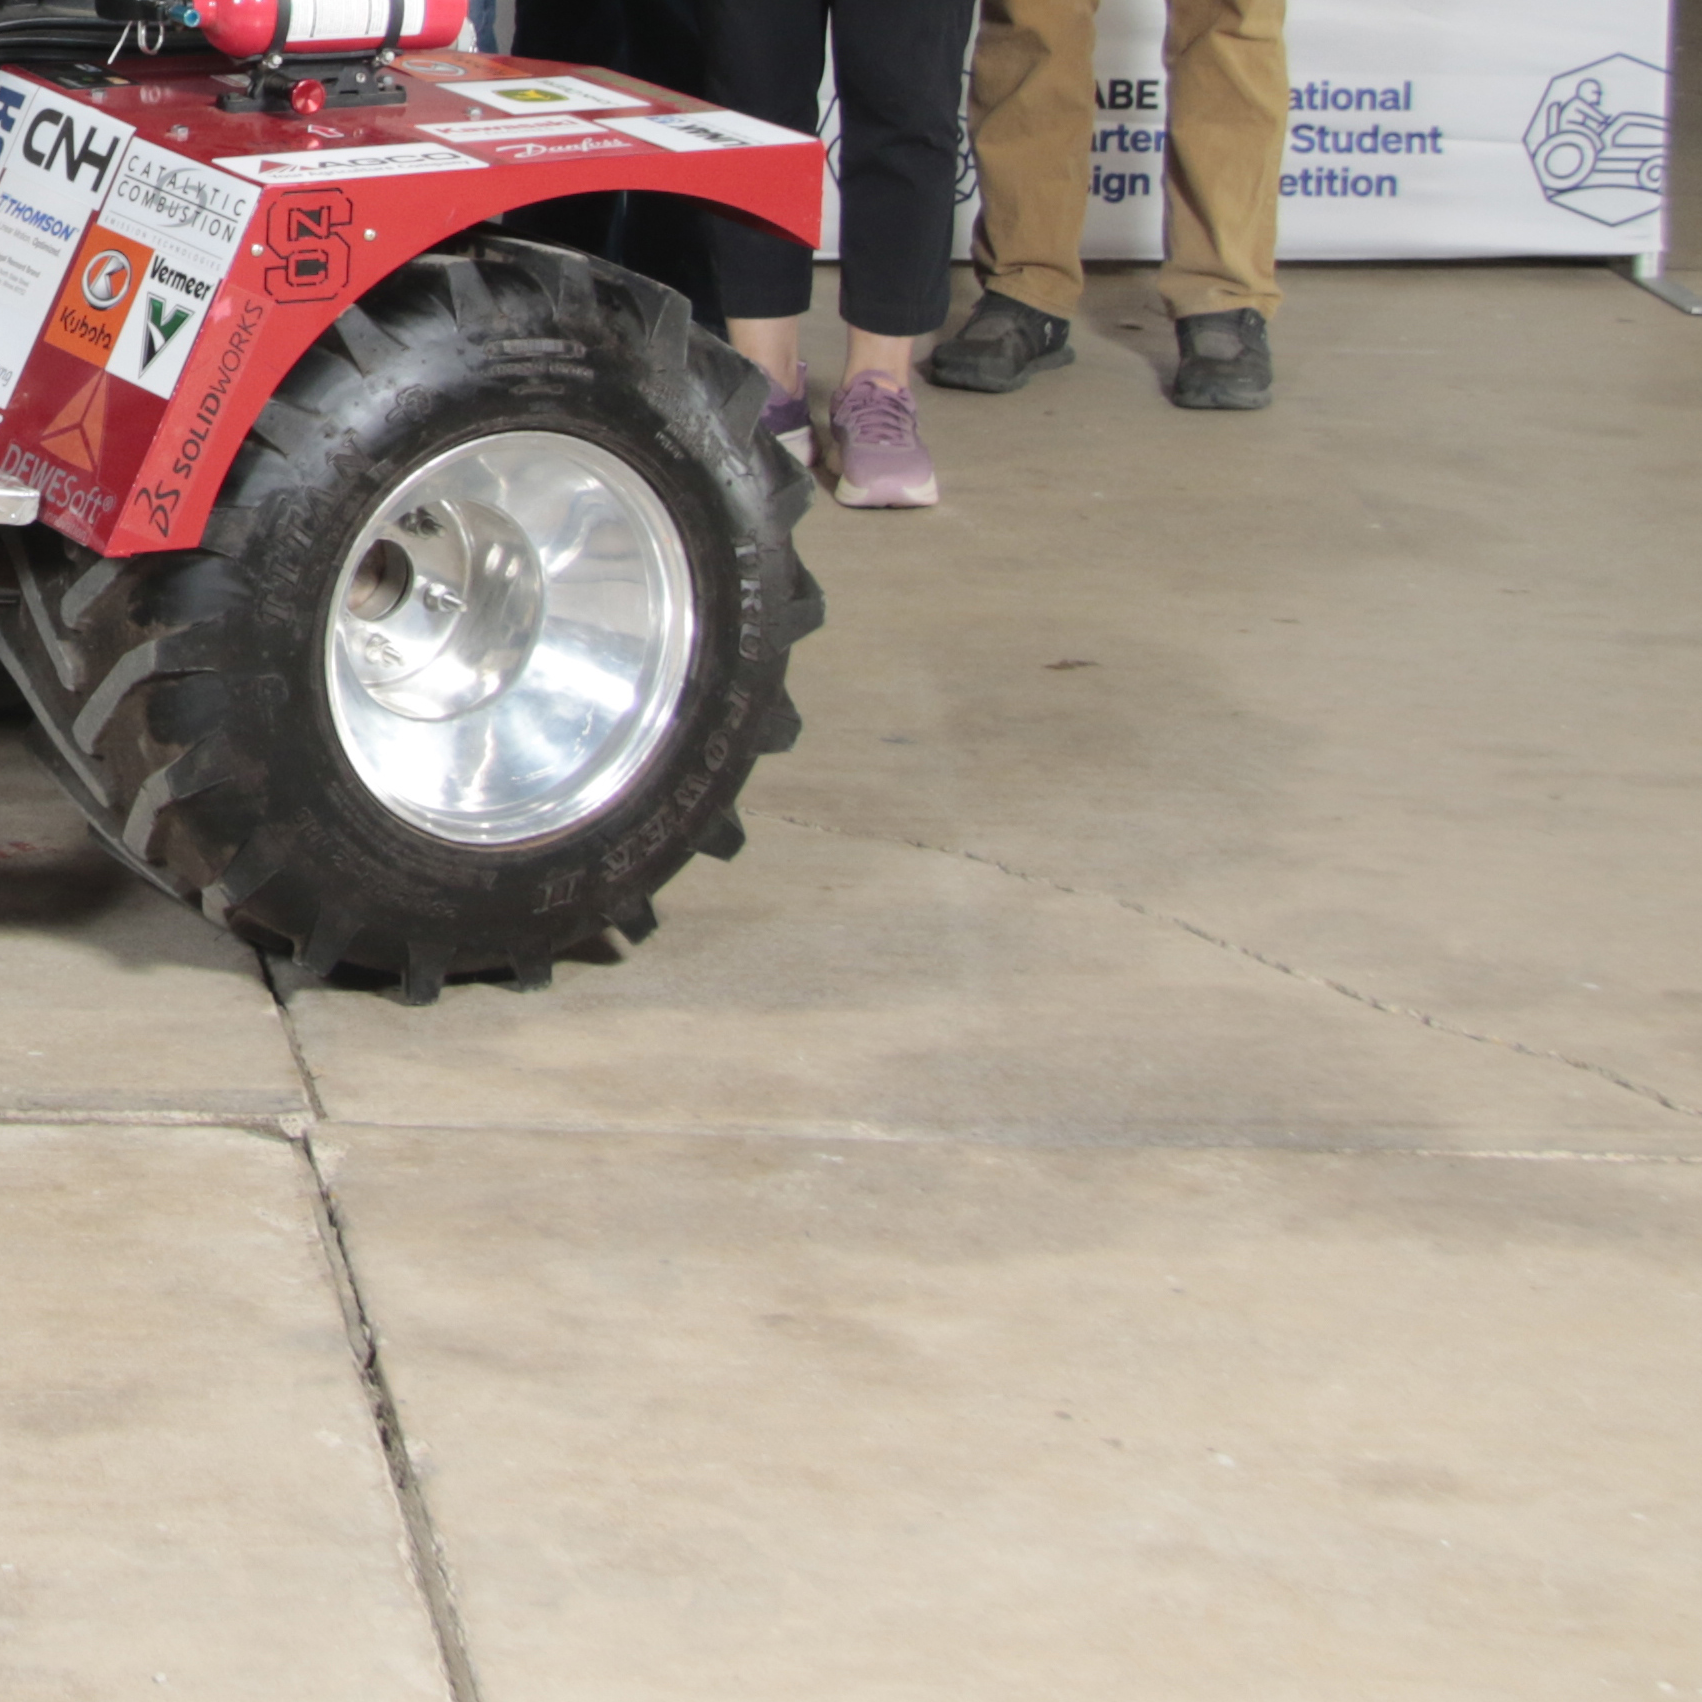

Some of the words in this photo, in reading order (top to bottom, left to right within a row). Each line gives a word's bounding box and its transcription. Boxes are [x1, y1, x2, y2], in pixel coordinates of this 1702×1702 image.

[1288, 81, 1412, 112] ational
[22, 107, 120, 198] CNH
[317, 152, 462, 169] AGCO
[495, 138, 632, 159] Danfoss
[1290, 123, 1443, 154] Student
[128, 155, 246, 216] CATALYTIC
[1279, 166, 1398, 197] etition
[117, 180, 236, 243] COMBUSTION
[150, 254, 214, 301] Vermeer
[60, 304, 112, 352] Kubota
[173, 299, 264, 480] SOLIDWORKS
